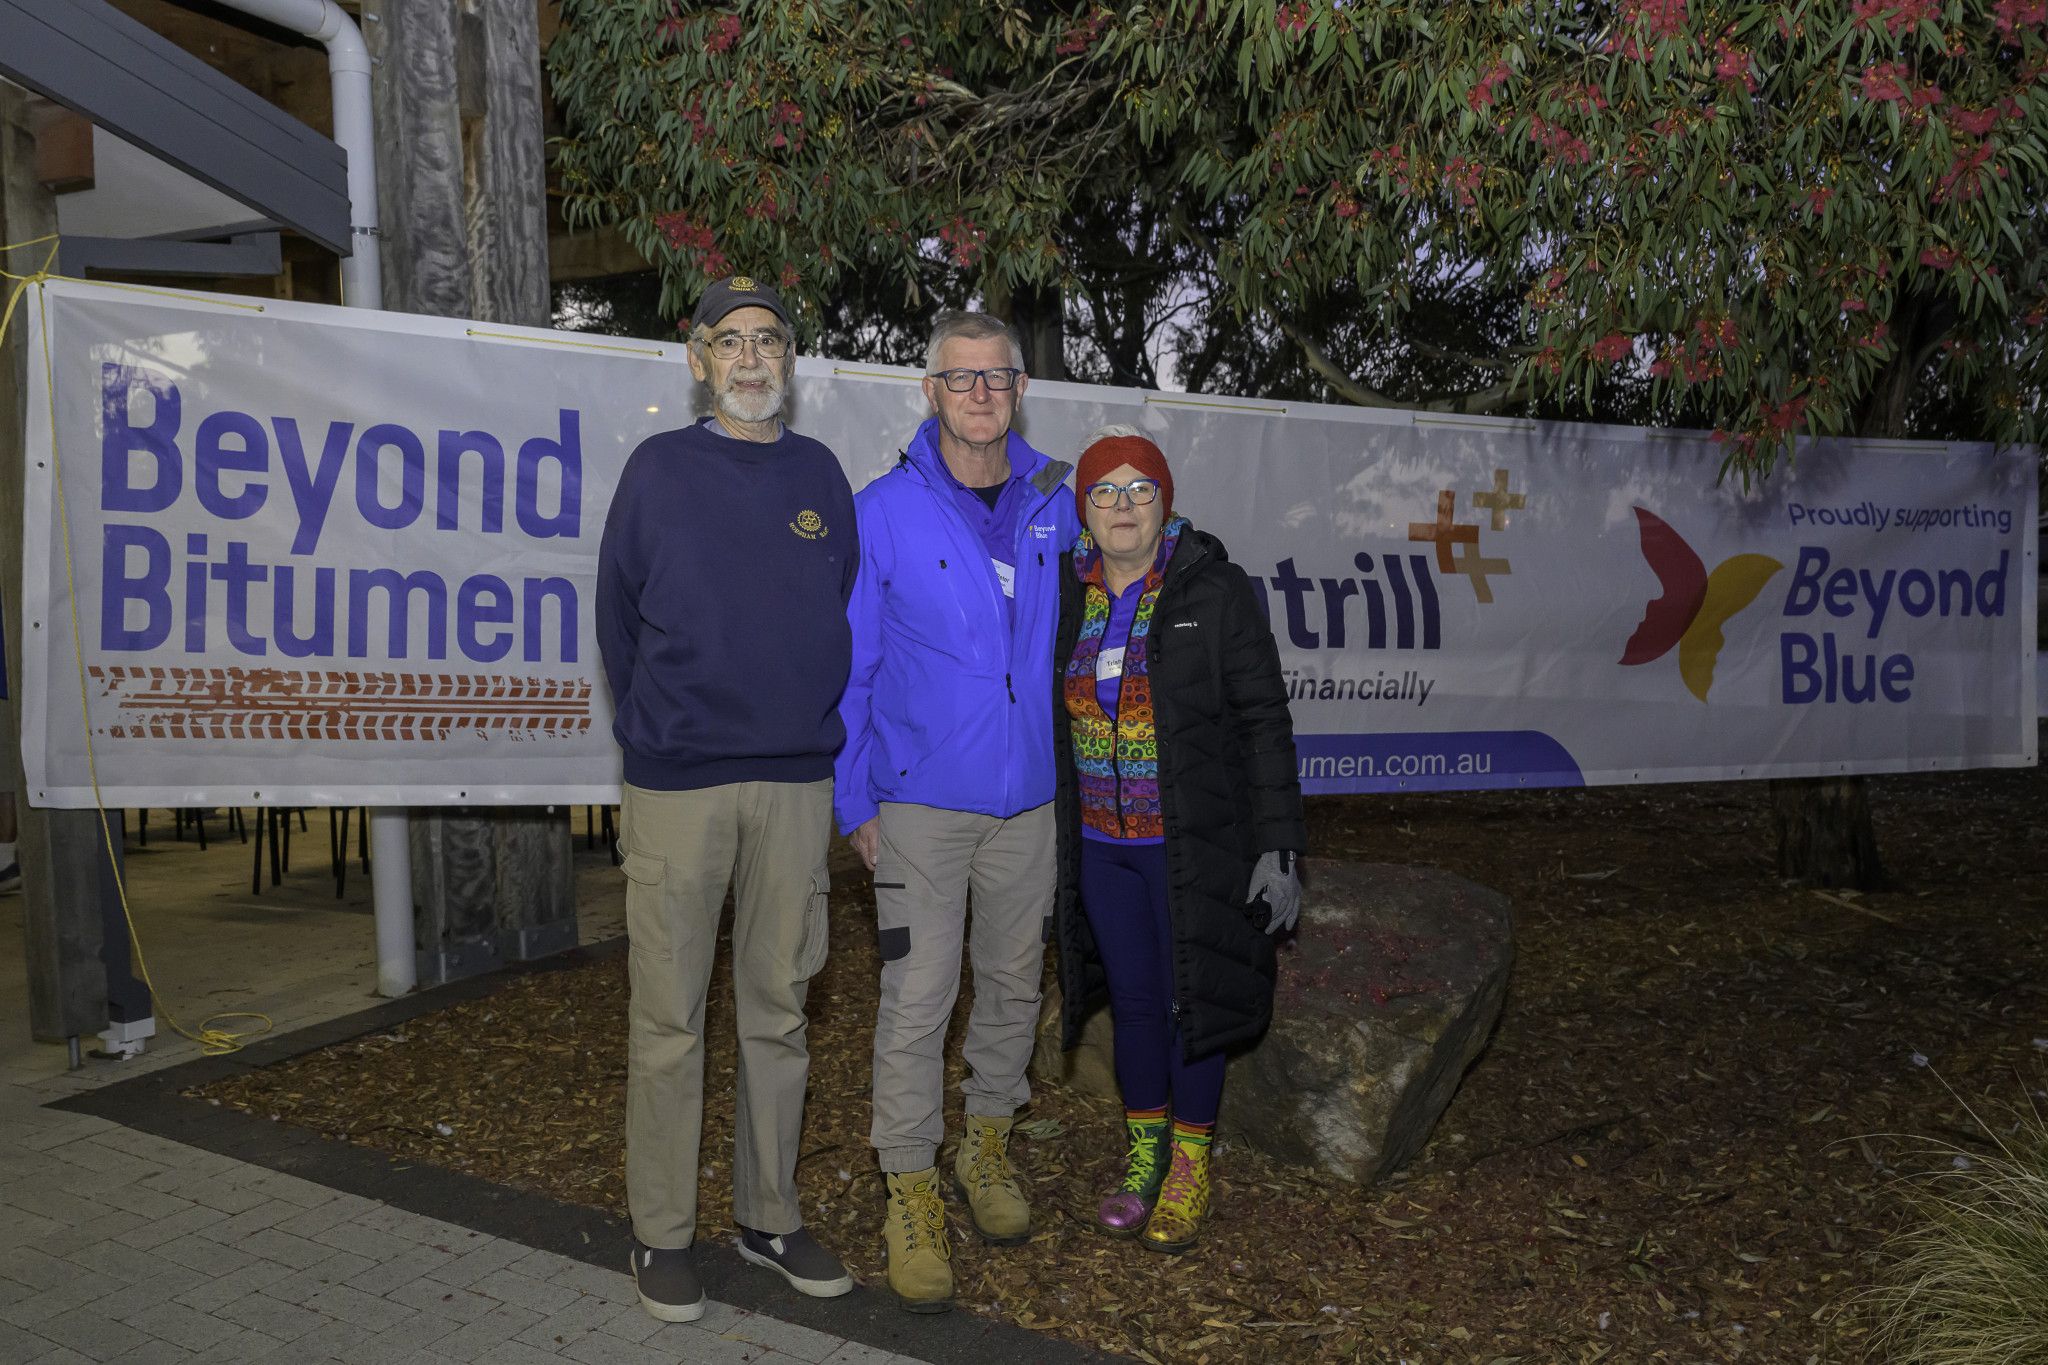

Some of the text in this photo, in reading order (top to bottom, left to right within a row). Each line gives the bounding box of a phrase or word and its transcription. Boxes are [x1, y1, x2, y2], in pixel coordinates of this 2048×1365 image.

[101, 361, 581, 555] Beyond
[1787, 502, 2013, 535] Proudly supporting
[101, 523, 578, 663] Bitumen
[1783, 545, 2011, 640] Beyond
[1780, 632, 1915, 705] Blue
